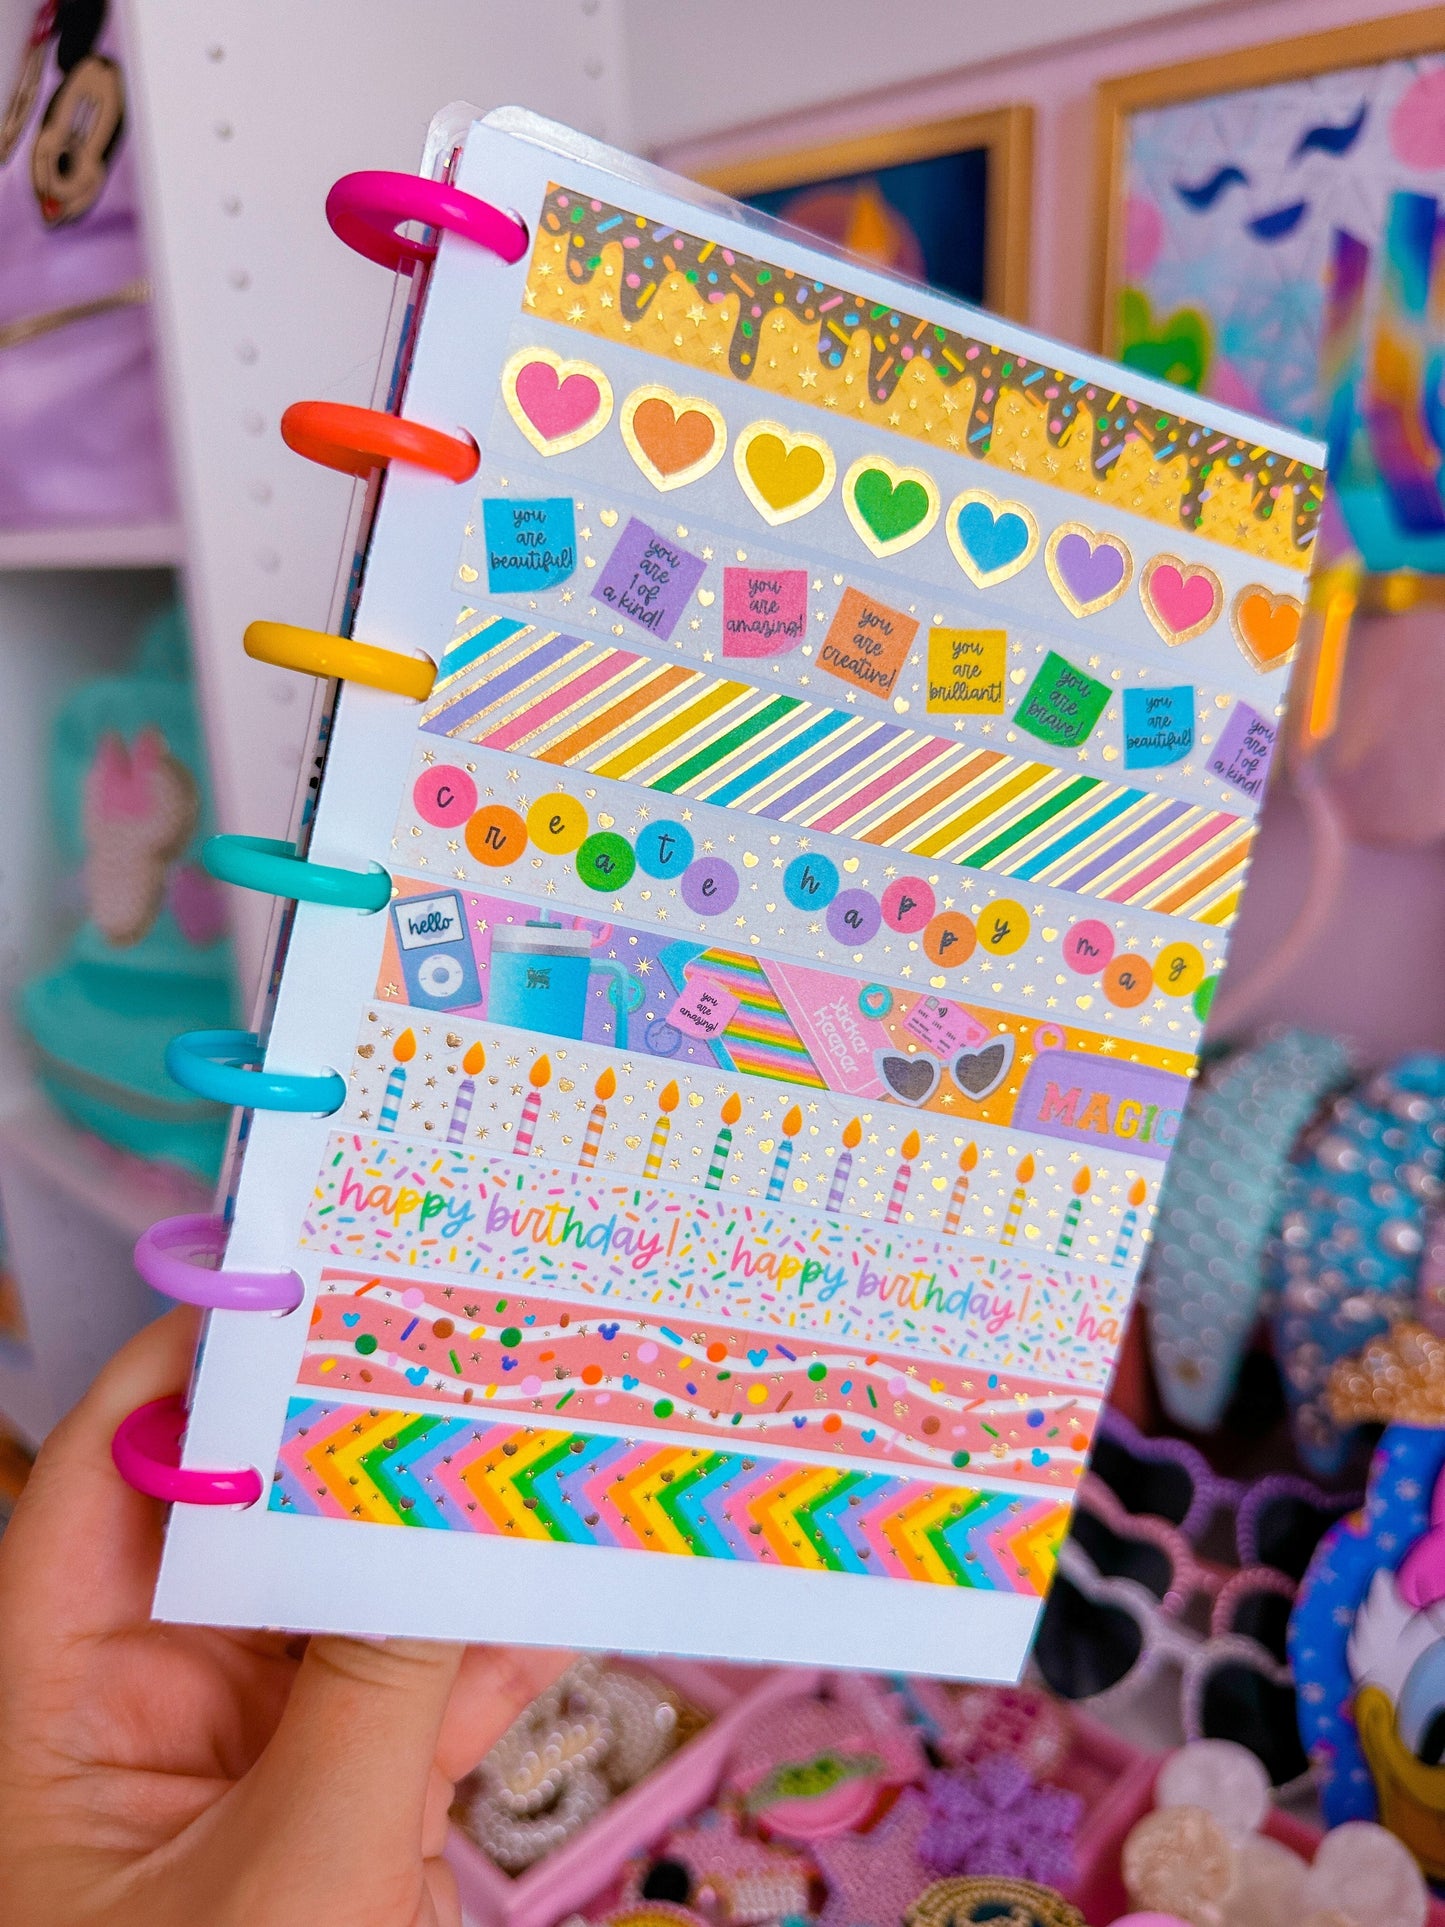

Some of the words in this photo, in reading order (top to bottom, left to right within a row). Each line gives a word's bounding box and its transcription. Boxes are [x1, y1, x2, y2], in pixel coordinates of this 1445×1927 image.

[512, 510, 547, 528] you
[516, 531, 547, 547] are
[490, 546, 573, 572] beautiful!
[644, 539, 681, 568] you
[640, 559, 670, 583] are
[629, 573, 639, 590] 1
[638, 584, 660, 606] of
[748, 578, 782, 598] you
[602, 586, 617, 602] a
[618, 590, 665, 631] kind!
[749, 599, 780, 615] are
[726, 613, 803, 638] amazing!
[858, 608, 893, 636] you
[853, 633, 883, 657] are
[951, 640, 984, 659] you
[822, 645, 897, 692] creative!
[952, 663, 982, 680] are
[928, 681, 1002, 703] brilliant!
[1056, 668, 1091, 697] you
[1049, 690, 1078, 716] are
[1145, 696, 1172, 714] you
[1026, 696, 1084, 741] brave!
[1148, 716, 1172, 729] are
[1248, 718, 1276, 743] you
[1126, 728, 1192, 751] beautiful!
[1243, 736, 1267, 757] are
[1213, 760, 1225, 774] a
[1225, 763, 1262, 797] kind!
[1241, 758, 1259, 776] of
[408, 911, 454, 935] hello
[696, 1003, 712, 1016] are
[700, 992, 718, 1007] you
[679, 1007, 719, 1032] amazing!
[813, 1005, 860, 1074] Keeper
[1037, 1081, 1183, 1147] MAGIC
[339, 1167, 477, 1239] happy
[485, 1192, 681, 1270] birthday!
[730, 1235, 848, 1302] happy
[856, 1259, 1031, 1335] birthday!
